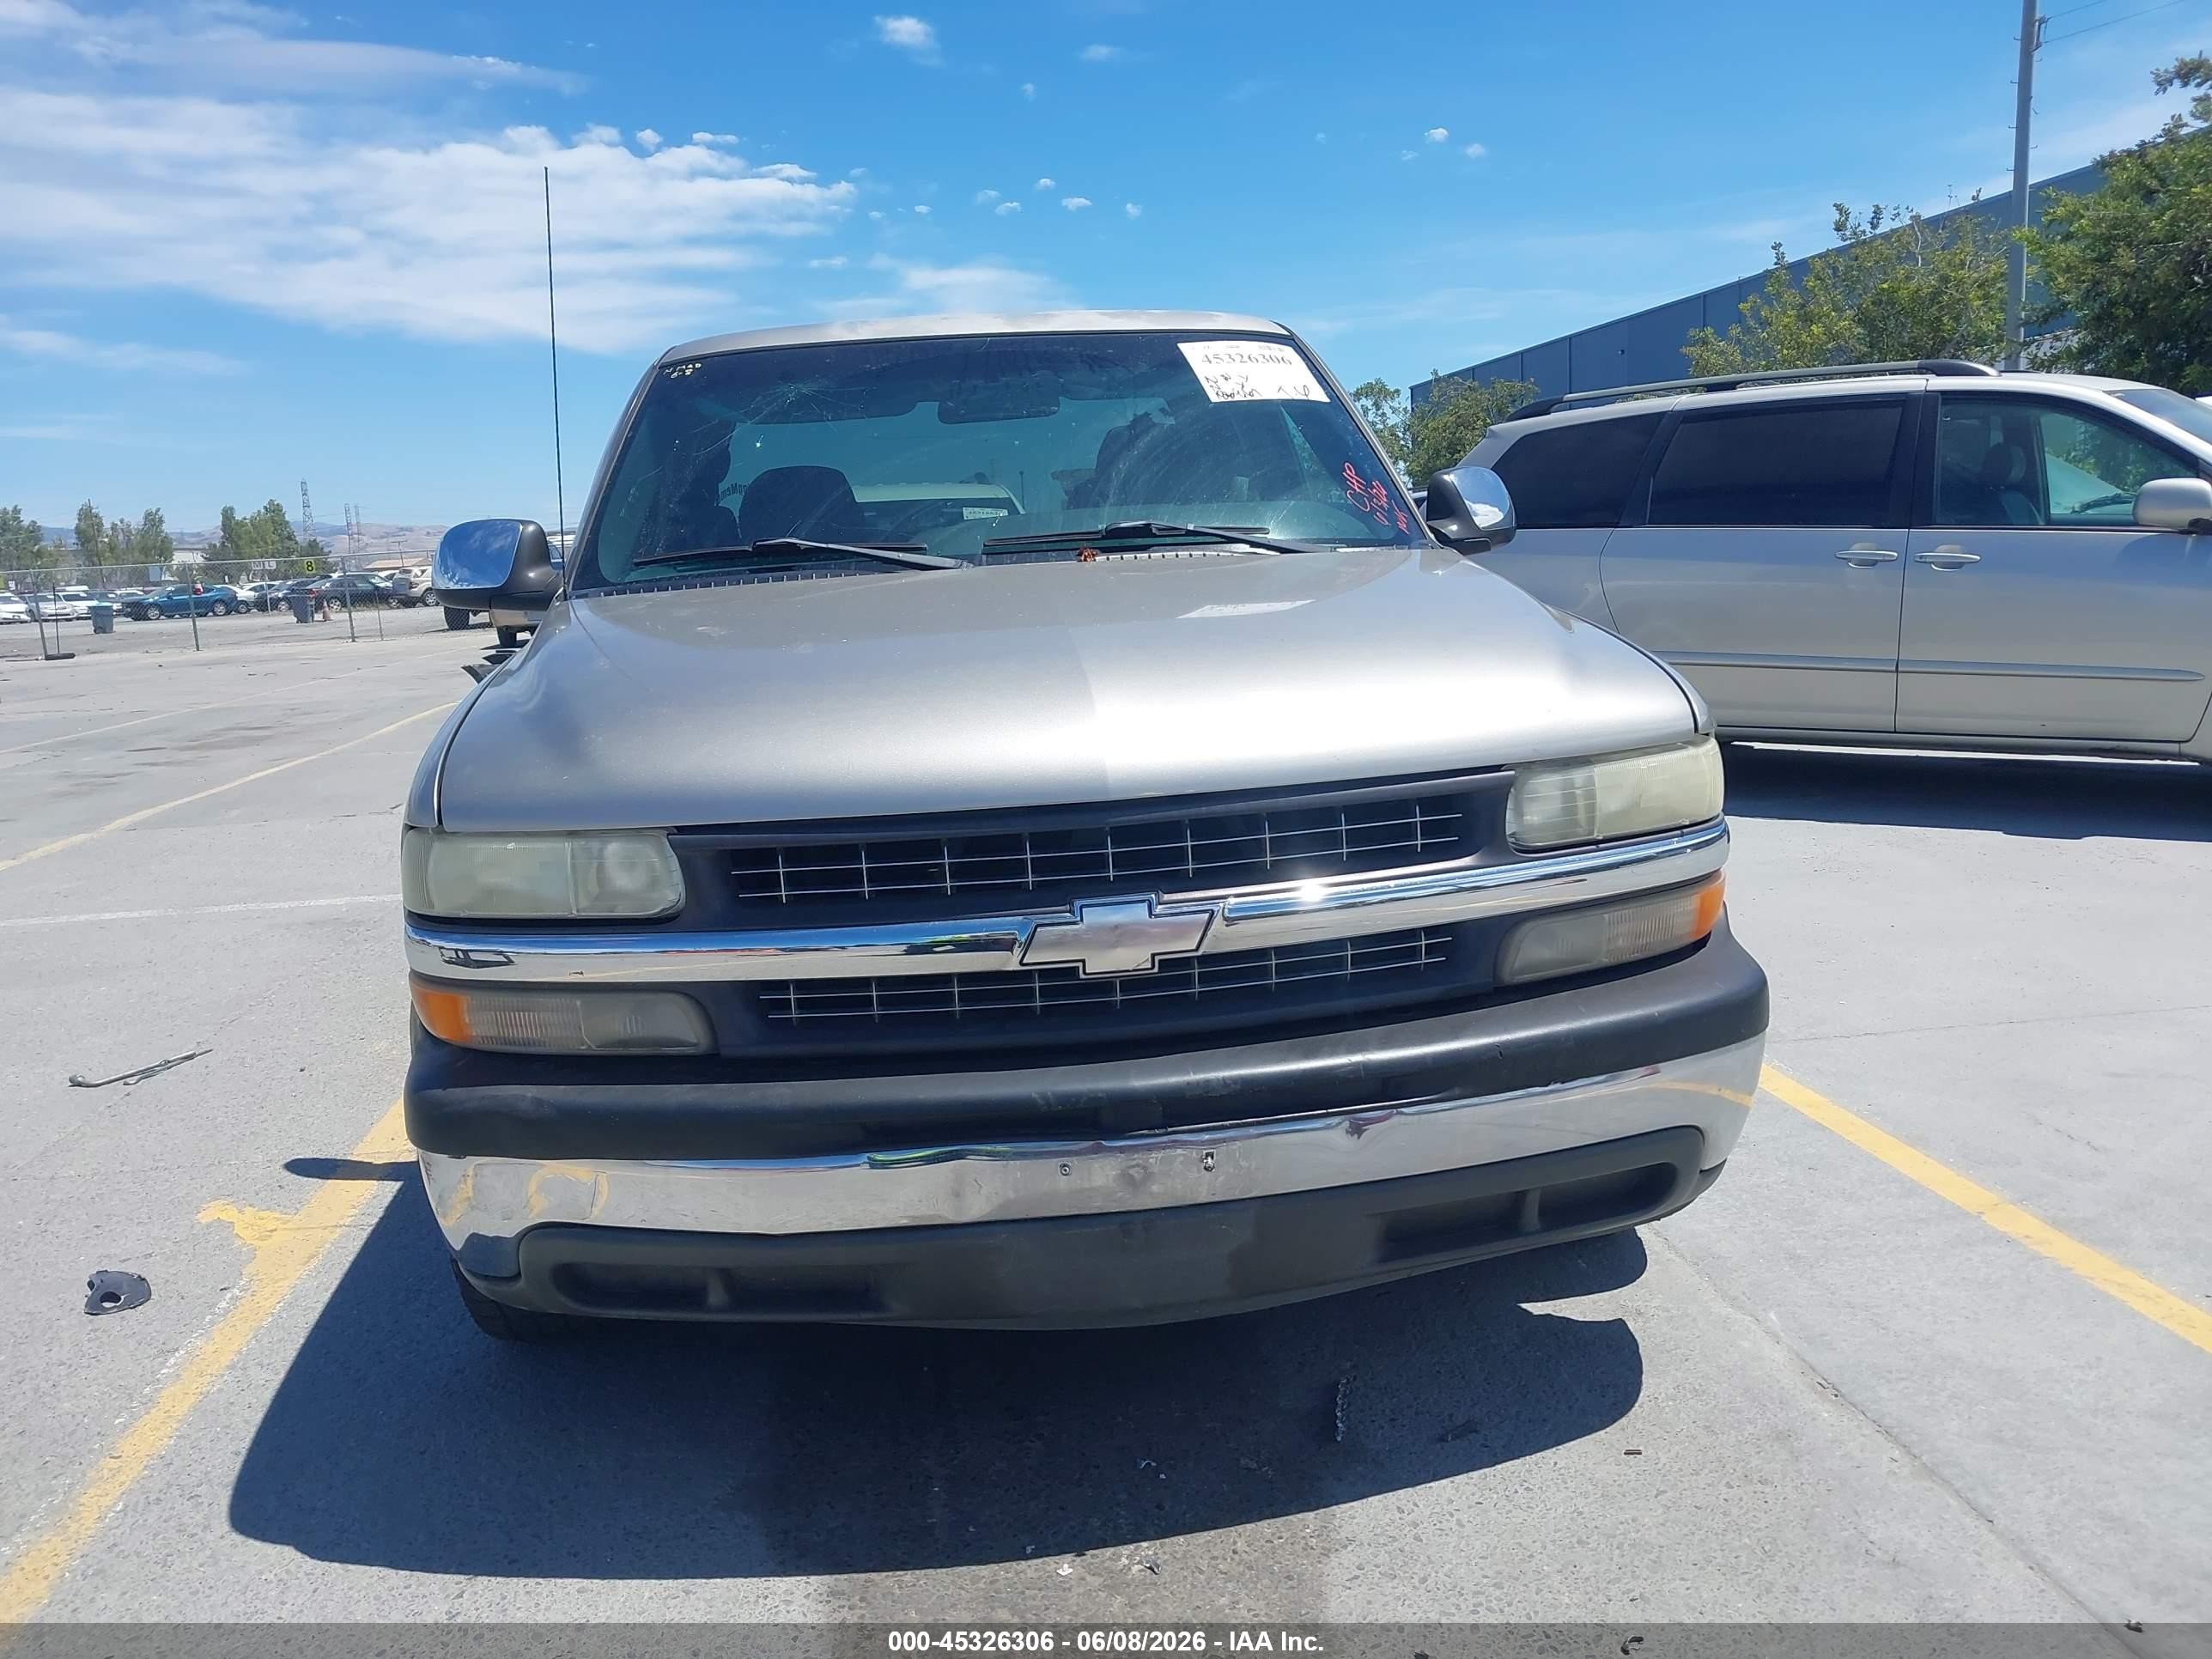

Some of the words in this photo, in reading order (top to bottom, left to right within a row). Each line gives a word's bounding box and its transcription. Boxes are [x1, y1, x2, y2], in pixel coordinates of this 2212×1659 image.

[1201, 353, 1292, 366] 45326306
[1342, 462, 1370, 512] CHP
[306, 561, 314, 572] 8
